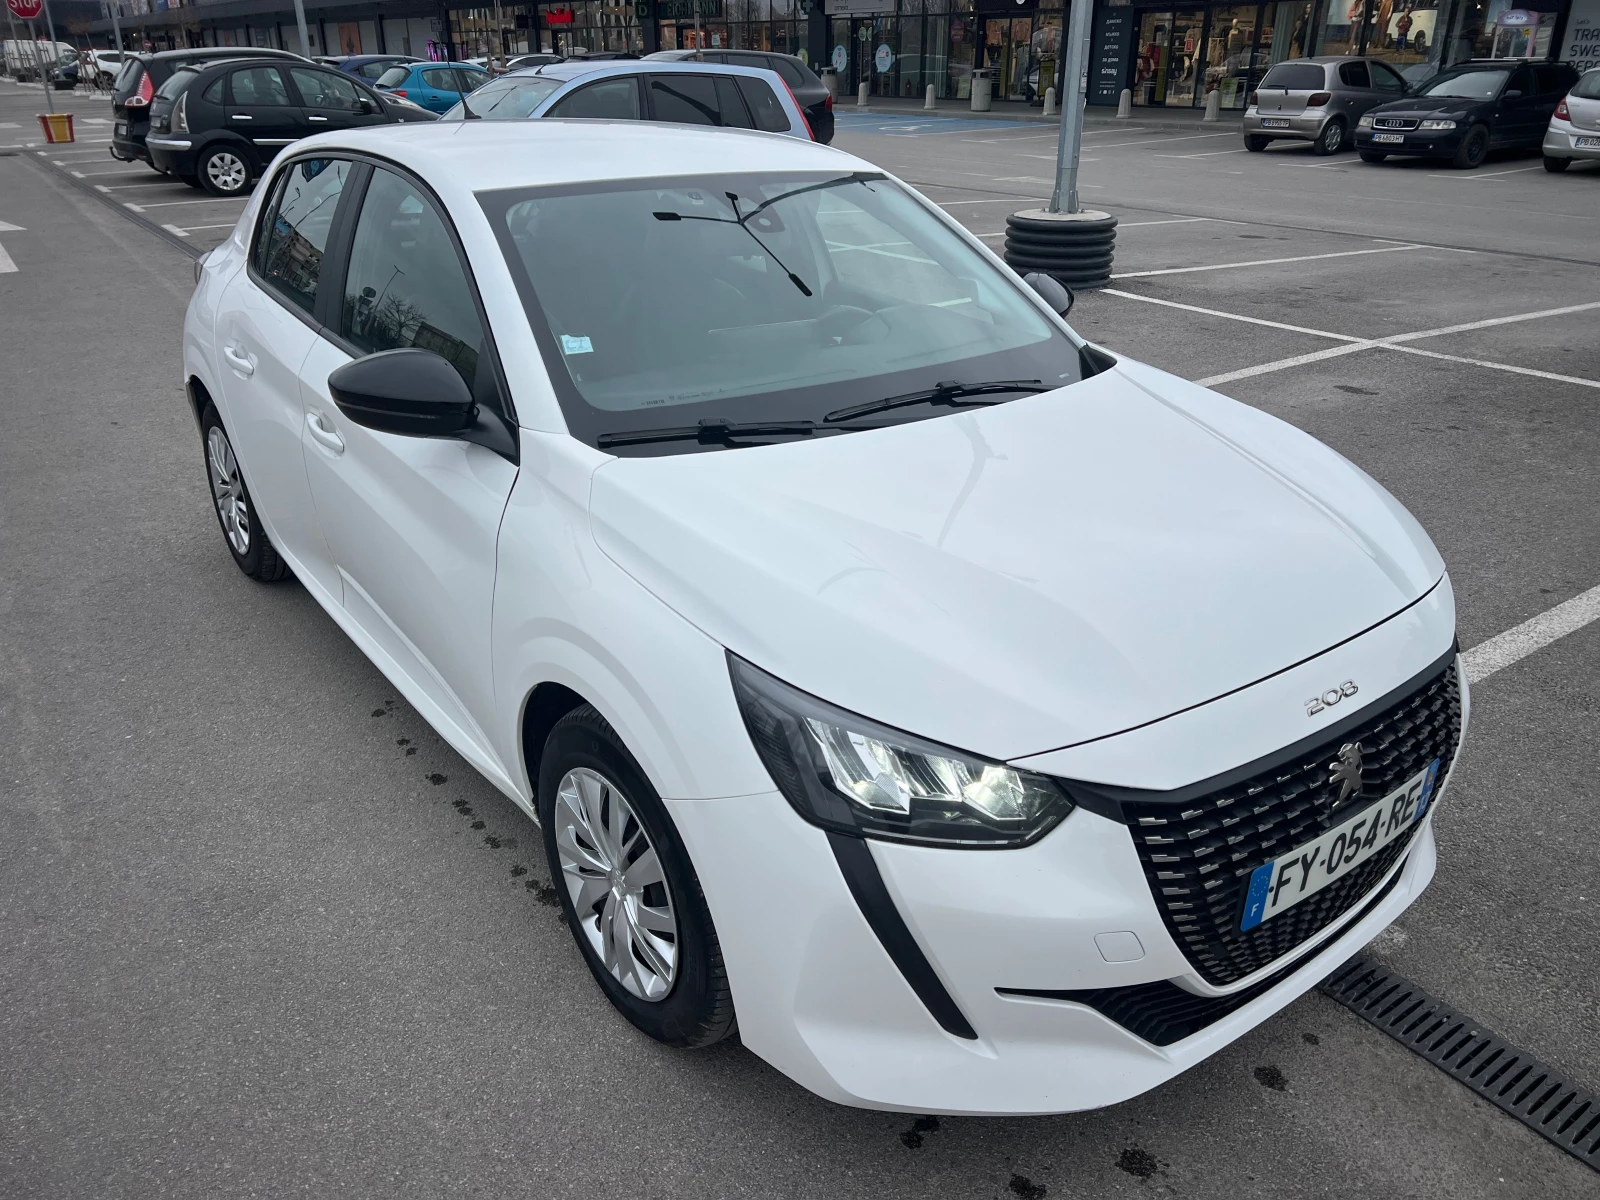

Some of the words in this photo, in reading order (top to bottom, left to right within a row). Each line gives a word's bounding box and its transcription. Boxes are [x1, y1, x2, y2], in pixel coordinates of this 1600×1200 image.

[1569, 44, 1600, 57] SWE
[1101, 67, 1118, 76] sinsay
[1304, 679, 1359, 717] 208
[1271, 779, 1424, 908] FY-054-RE
[1250, 903, 1260, 918] F
